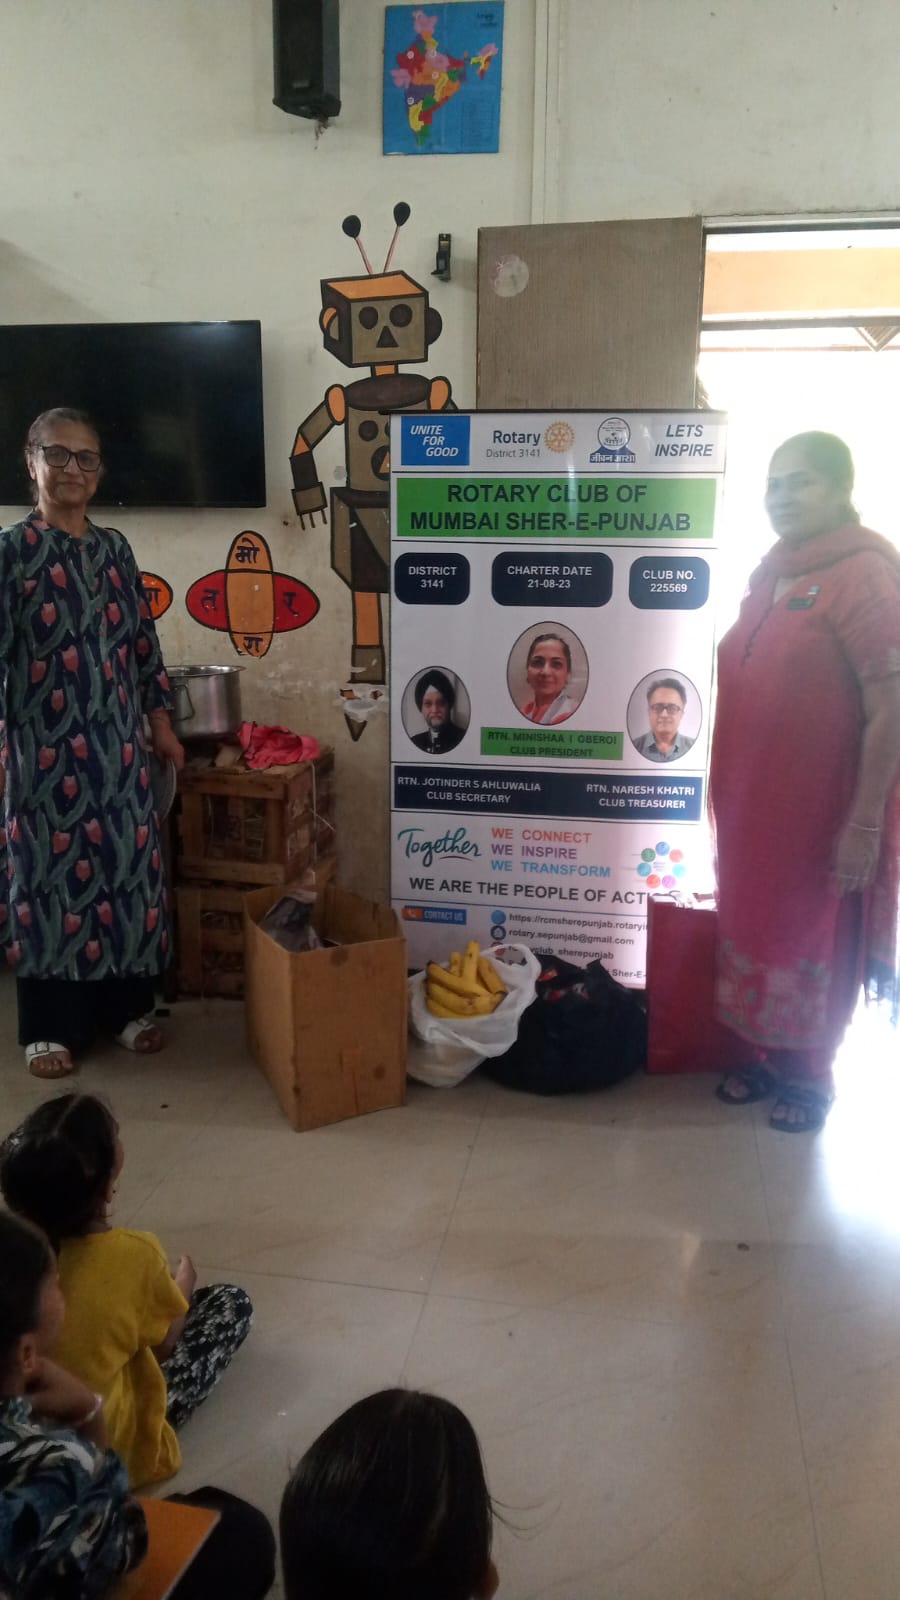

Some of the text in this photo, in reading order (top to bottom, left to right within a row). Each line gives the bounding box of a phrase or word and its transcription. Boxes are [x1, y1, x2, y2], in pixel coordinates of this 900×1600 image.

[410, 425, 443, 435] UNITE
[666, 424, 704, 437] LETS
[422, 436, 445, 446] FOR
[493, 430, 541, 446] Rotary
[425, 447, 459, 457] GOOD
[486, 449, 541, 458] District 3141
[655, 444, 714, 457] INSPIRE
[447, 484, 648, 503] ROTARY CLUB OF
[410, 512, 691, 531] MUMBAI SHER-E-PUNJAB
[408, 566, 458, 576] DISTRICT
[507, 565, 593, 576] CHARTER DATE
[642, 570, 697, 580] CLUB NO.
[420, 579, 444, 588] 3141
[527, 579, 571, 589] 21-08-23
[649, 583, 688, 593] 225569
[487, 731, 508, 741] RTN.
[513, 732, 565, 744] MINISHAA
[577, 735, 617, 745] OBEROI
[510, 746, 593, 757] CLUB PRESIDENT
[397, 776, 542, 792] RTN. JOTINDER S AHLUWALIA
[586, 783, 695, 796] RTN. NARESH KHATRI
[426, 791, 511, 804] CLUB SECRETARY
[598, 798, 686, 809] CLUB TREASURER
[491, 827, 592, 844] WE CONNECT
[397, 827, 482, 868] Together
[491, 844, 577, 860] WE INSPIRE
[491, 860, 611, 878] WE TRANSFORM
[409, 877, 435, 891] WE
[439, 879, 472, 893] ARE
[477, 882, 509, 896] THE
[514, 884, 579, 901] PEOPLE
[584, 888, 607, 902] OF
[424, 910, 464, 921] CONTACT US
